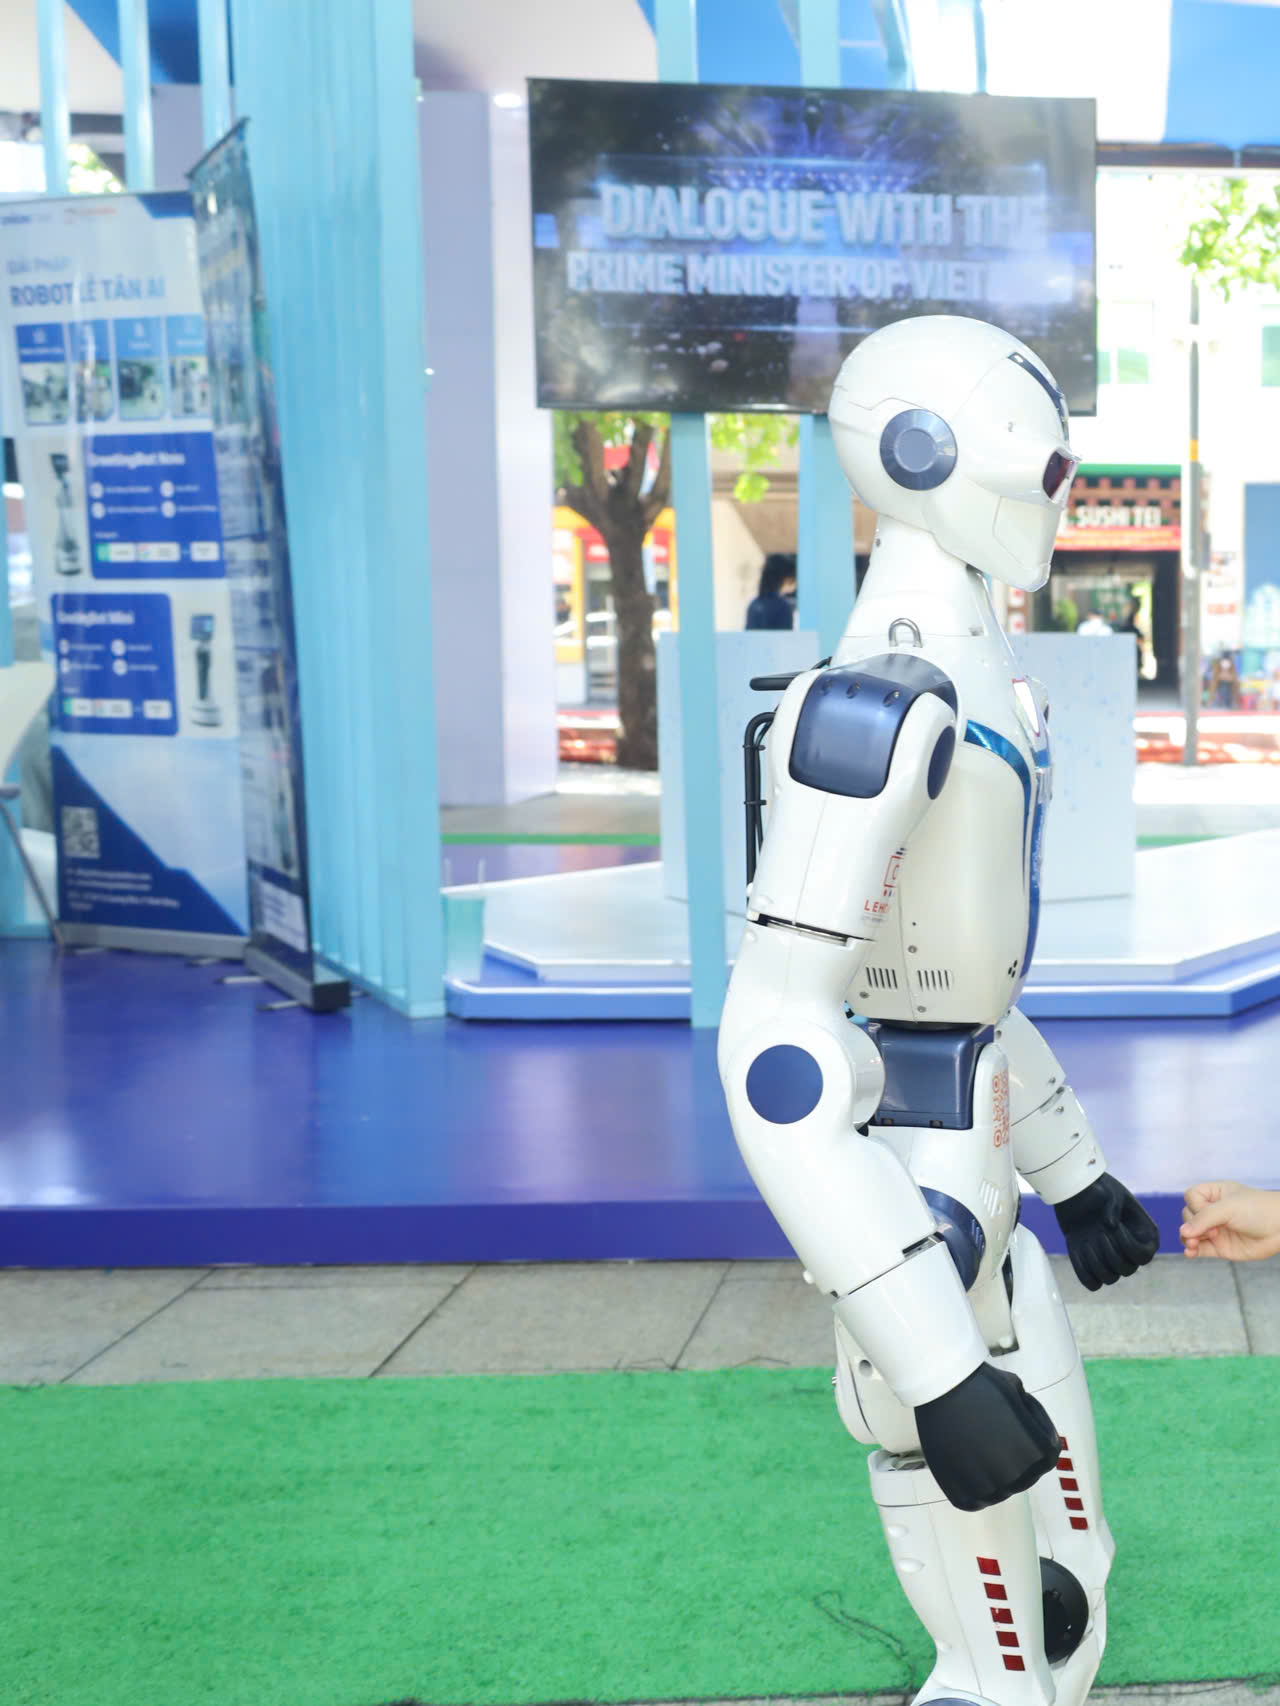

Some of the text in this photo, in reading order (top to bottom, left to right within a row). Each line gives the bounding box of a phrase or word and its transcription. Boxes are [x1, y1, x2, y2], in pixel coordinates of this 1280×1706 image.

[600, 182, 826, 243] DIALOGUE
[836, 190, 953, 247] WITH
[566, 250, 685, 294] PRIME
[687, 256, 856, 299] MINISTER
[861, 261, 905, 300] OF
[10, 283, 73, 306] ROBOT
[1133, 505, 1161, 528] TEI
